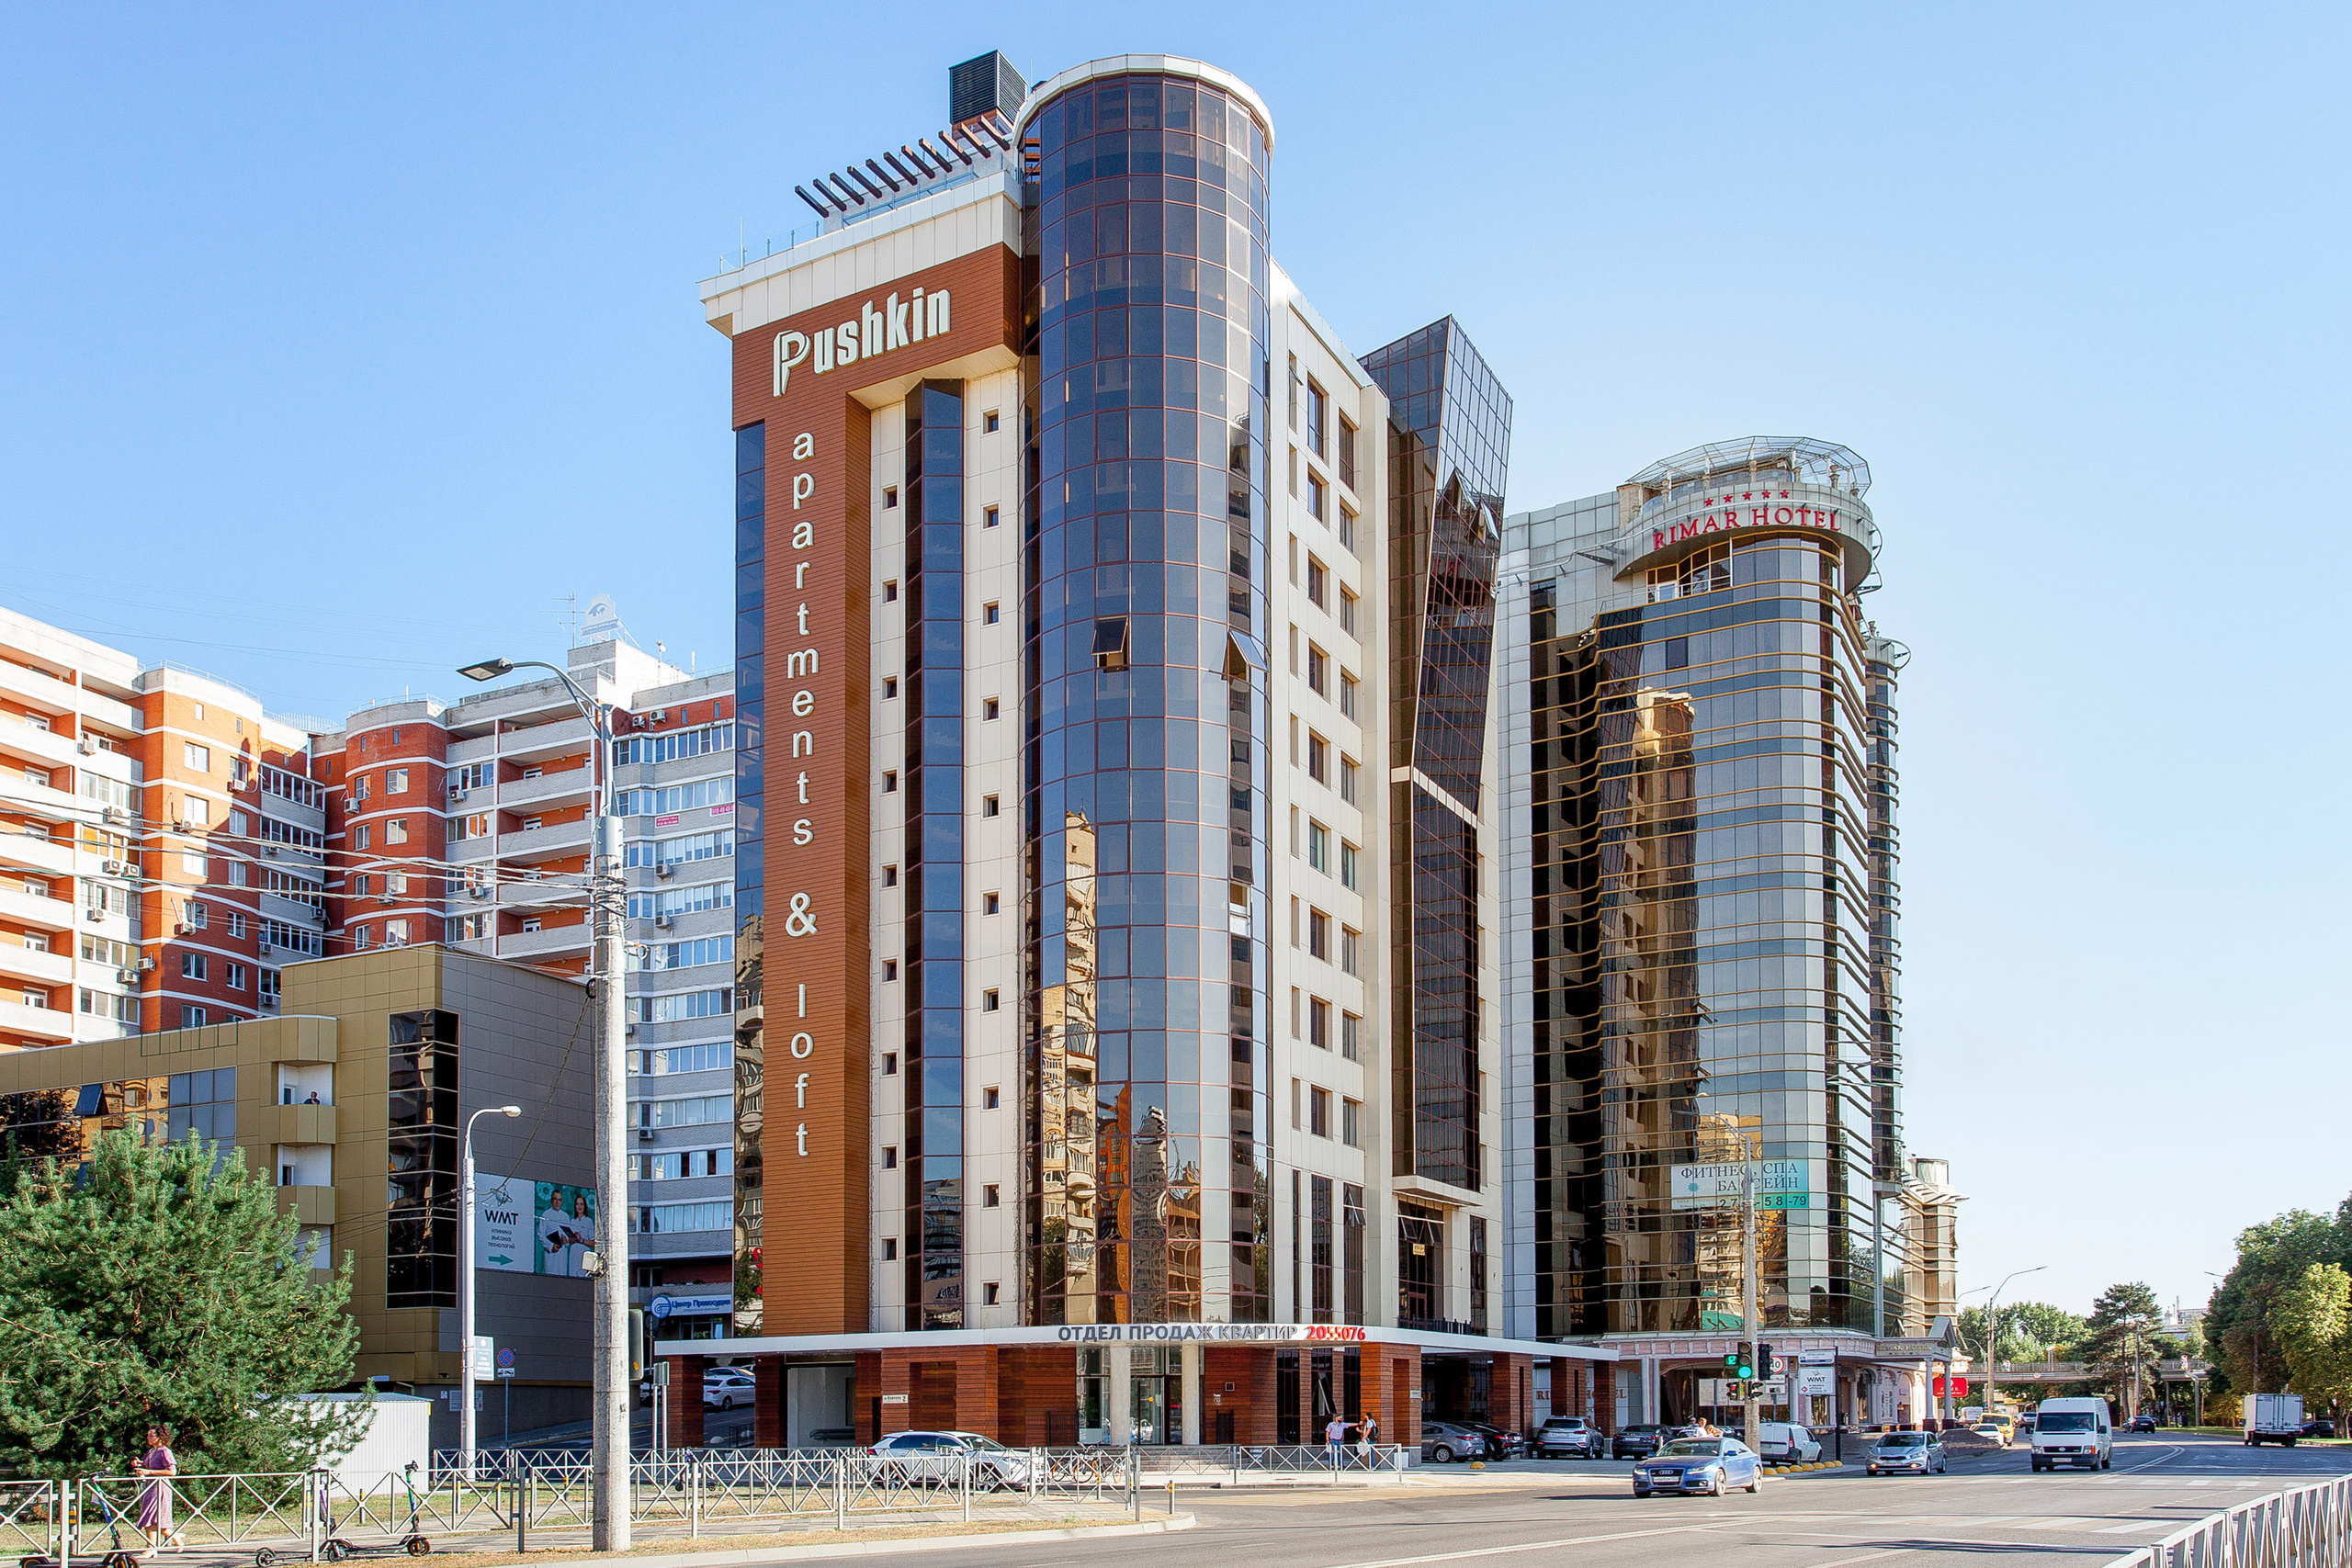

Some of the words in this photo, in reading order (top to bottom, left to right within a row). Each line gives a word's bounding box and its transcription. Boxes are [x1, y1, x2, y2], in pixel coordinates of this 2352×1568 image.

[773, 287, 952, 398] Pushkin
[1654, 511, 1741, 550] RIMAR
[1751, 507, 1841, 531] HOTEL
[787, 431, 819, 846] apartments
[785, 891, 819, 938] &
[790, 983, 815, 1156] loft
[1763, 1162, 1798, 1174] СПА
[484, 1209, 519, 1225] WMT
[672, 1300, 692, 1309] Центр
[1058, 1325, 1121, 1342] ОТДЕЛ
[1129, 1325, 1213, 1341] ПРОДАЖ
[1218, 1325, 1297, 1340] КВАРТИР
[1305, 1325, 1366, 1340] 2055076
